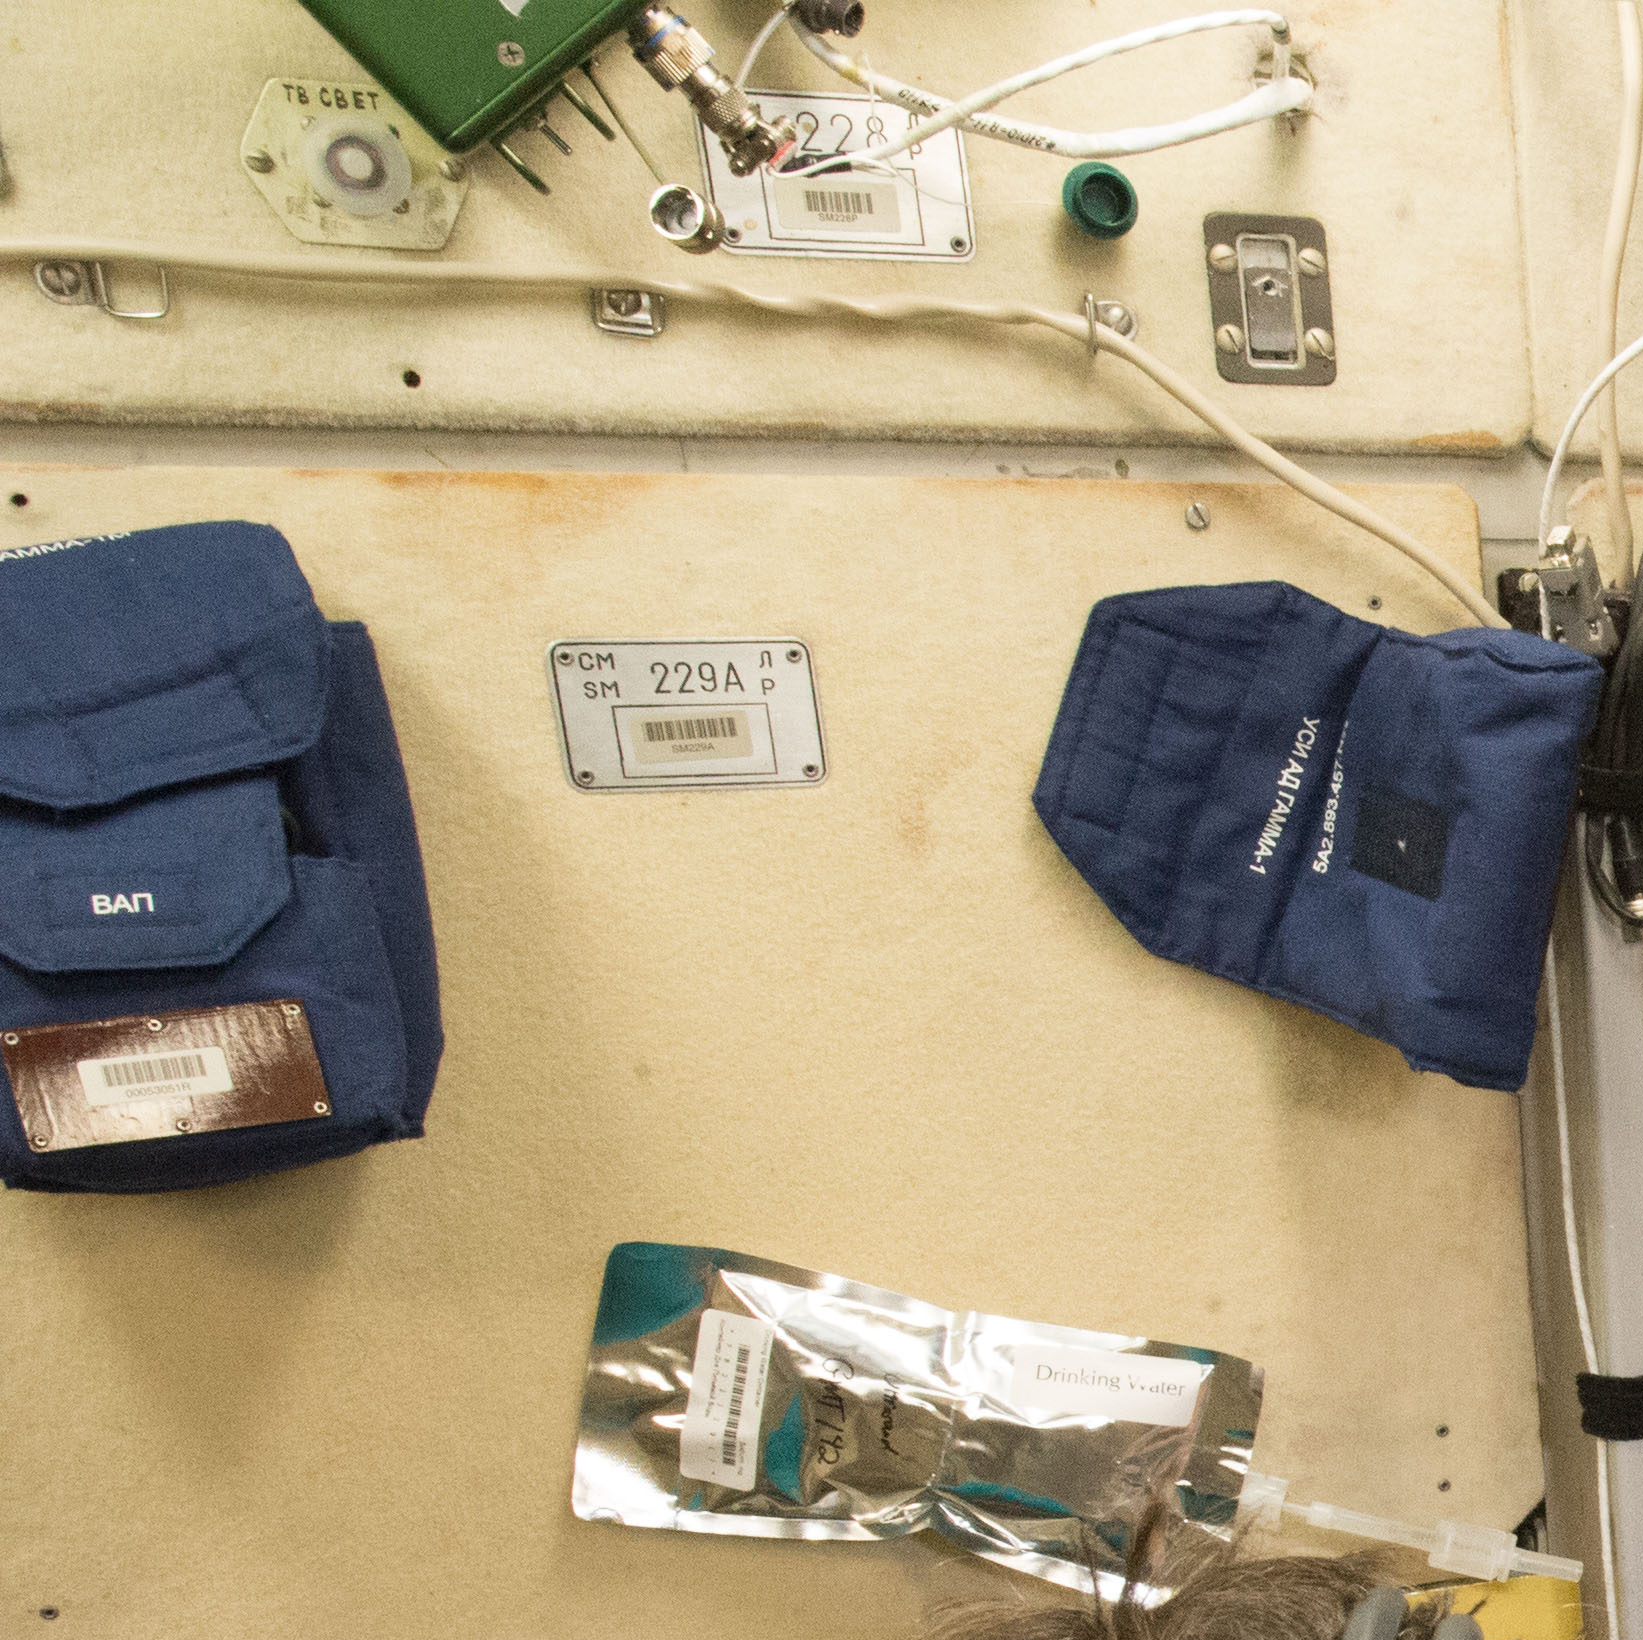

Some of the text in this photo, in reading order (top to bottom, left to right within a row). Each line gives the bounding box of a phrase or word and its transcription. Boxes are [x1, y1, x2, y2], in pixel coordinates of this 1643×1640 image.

[583, 680, 621, 699] SM
[650, 661, 745, 694] 229A
[1249, 716, 1320, 875] УСИ АД ГАММА-1
[1035, 1364, 1120, 1392] Drinking
